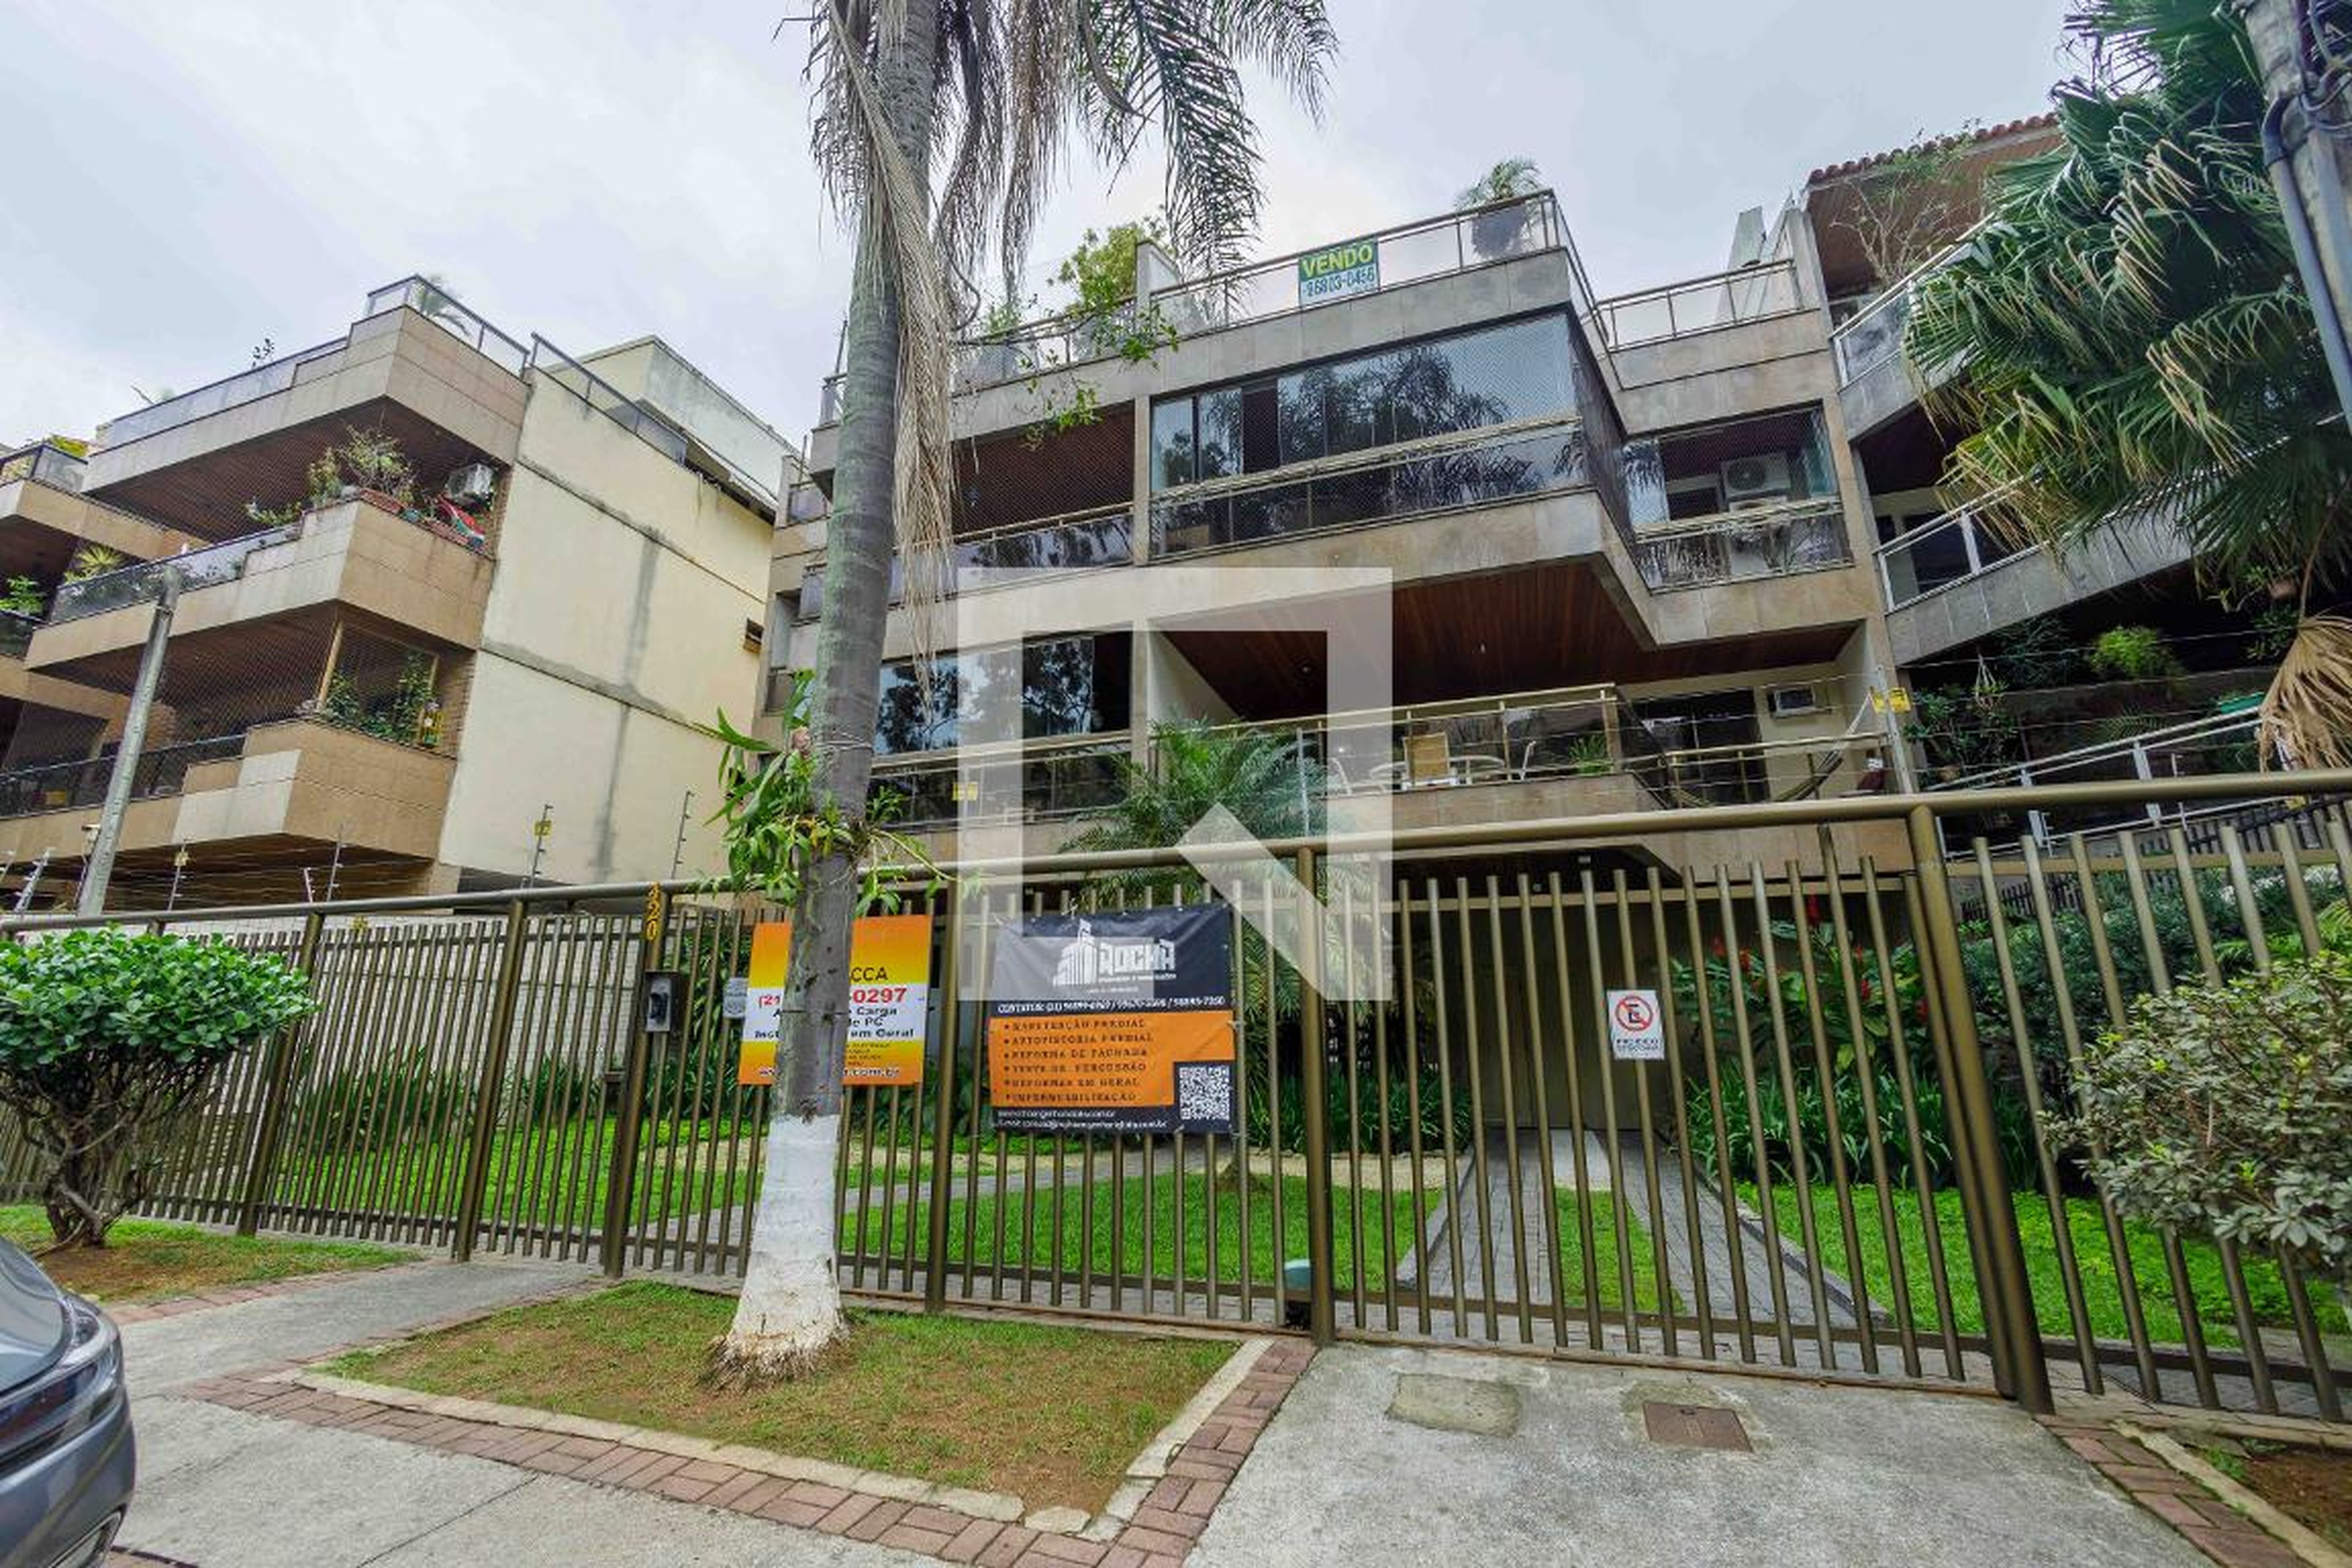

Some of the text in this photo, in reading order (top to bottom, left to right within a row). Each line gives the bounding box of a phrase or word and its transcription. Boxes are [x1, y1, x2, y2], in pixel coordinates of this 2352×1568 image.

[1302, 244, 1373, 277] VENDO
[851, 967, 888, 981] CCA
[759, 996, 780, 1008] (21
[1072, 1049, 1087, 1058] DE
